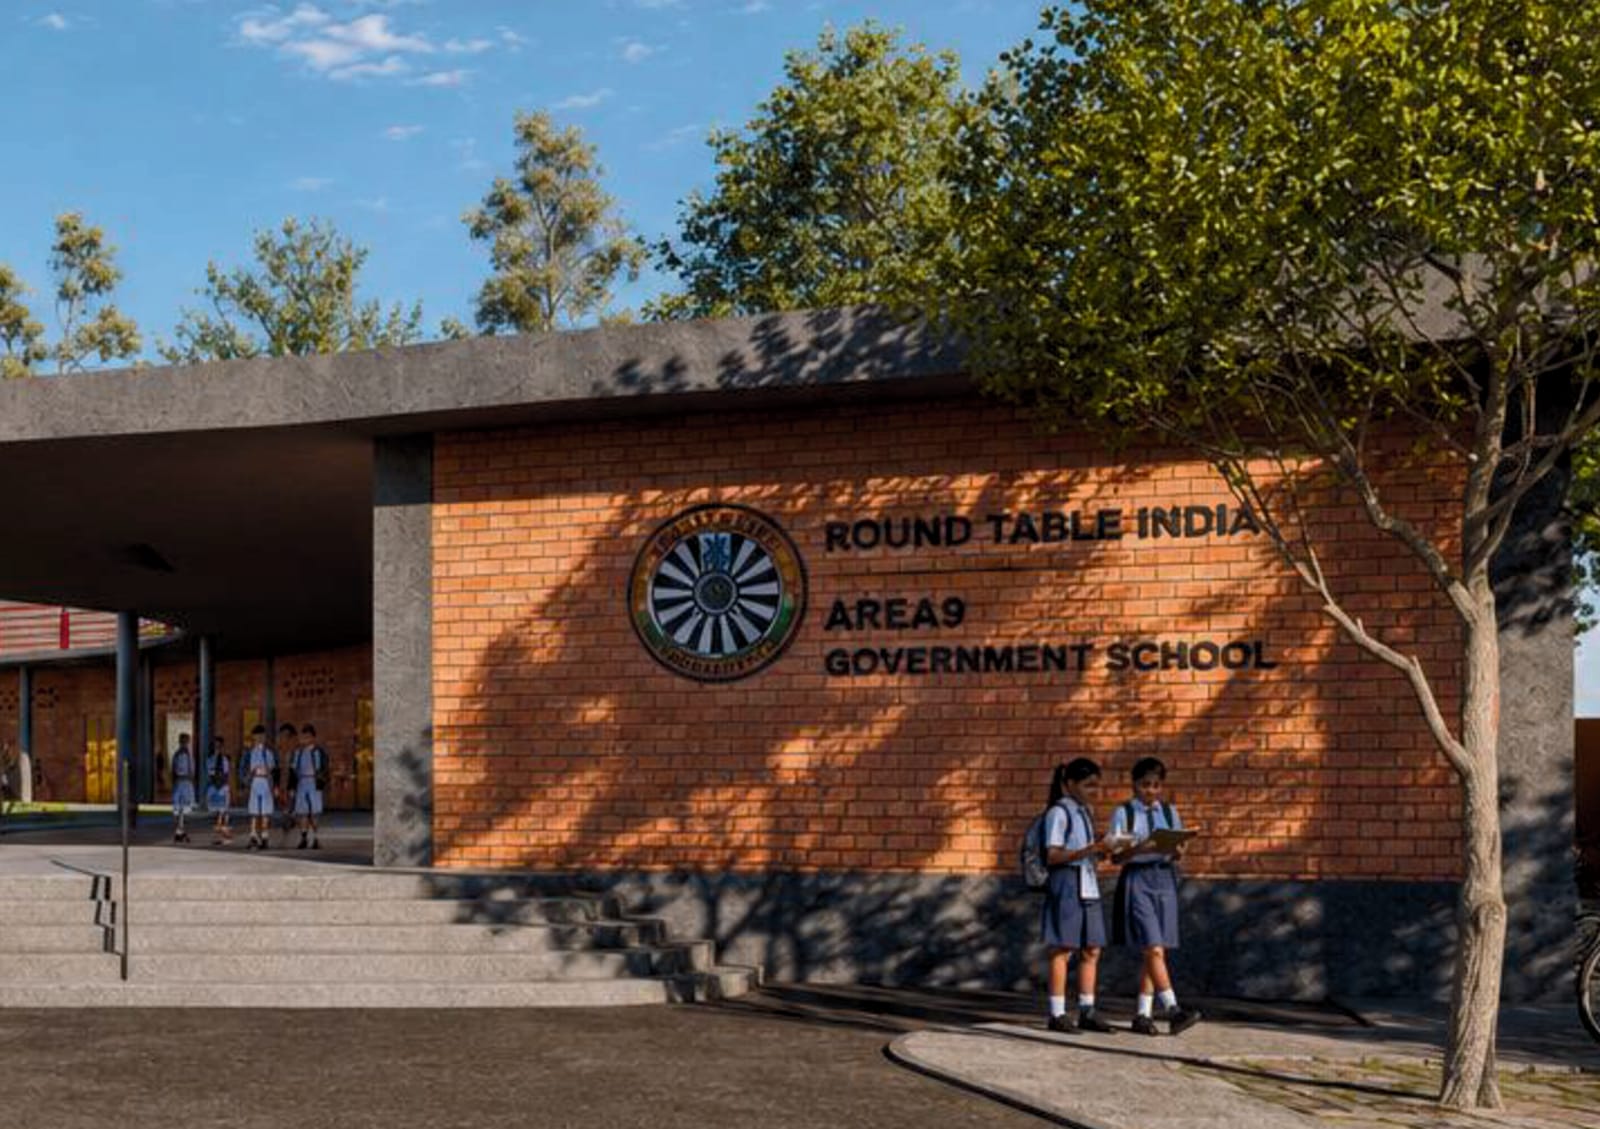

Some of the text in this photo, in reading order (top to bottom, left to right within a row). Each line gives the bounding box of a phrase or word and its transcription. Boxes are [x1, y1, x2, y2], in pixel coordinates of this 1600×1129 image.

[825, 504, 1261, 552] ROUND TABLE INDIA
[824, 597, 965, 631] AREA9
[825, 640, 1277, 676] GOVERNMENT SCHOOL
